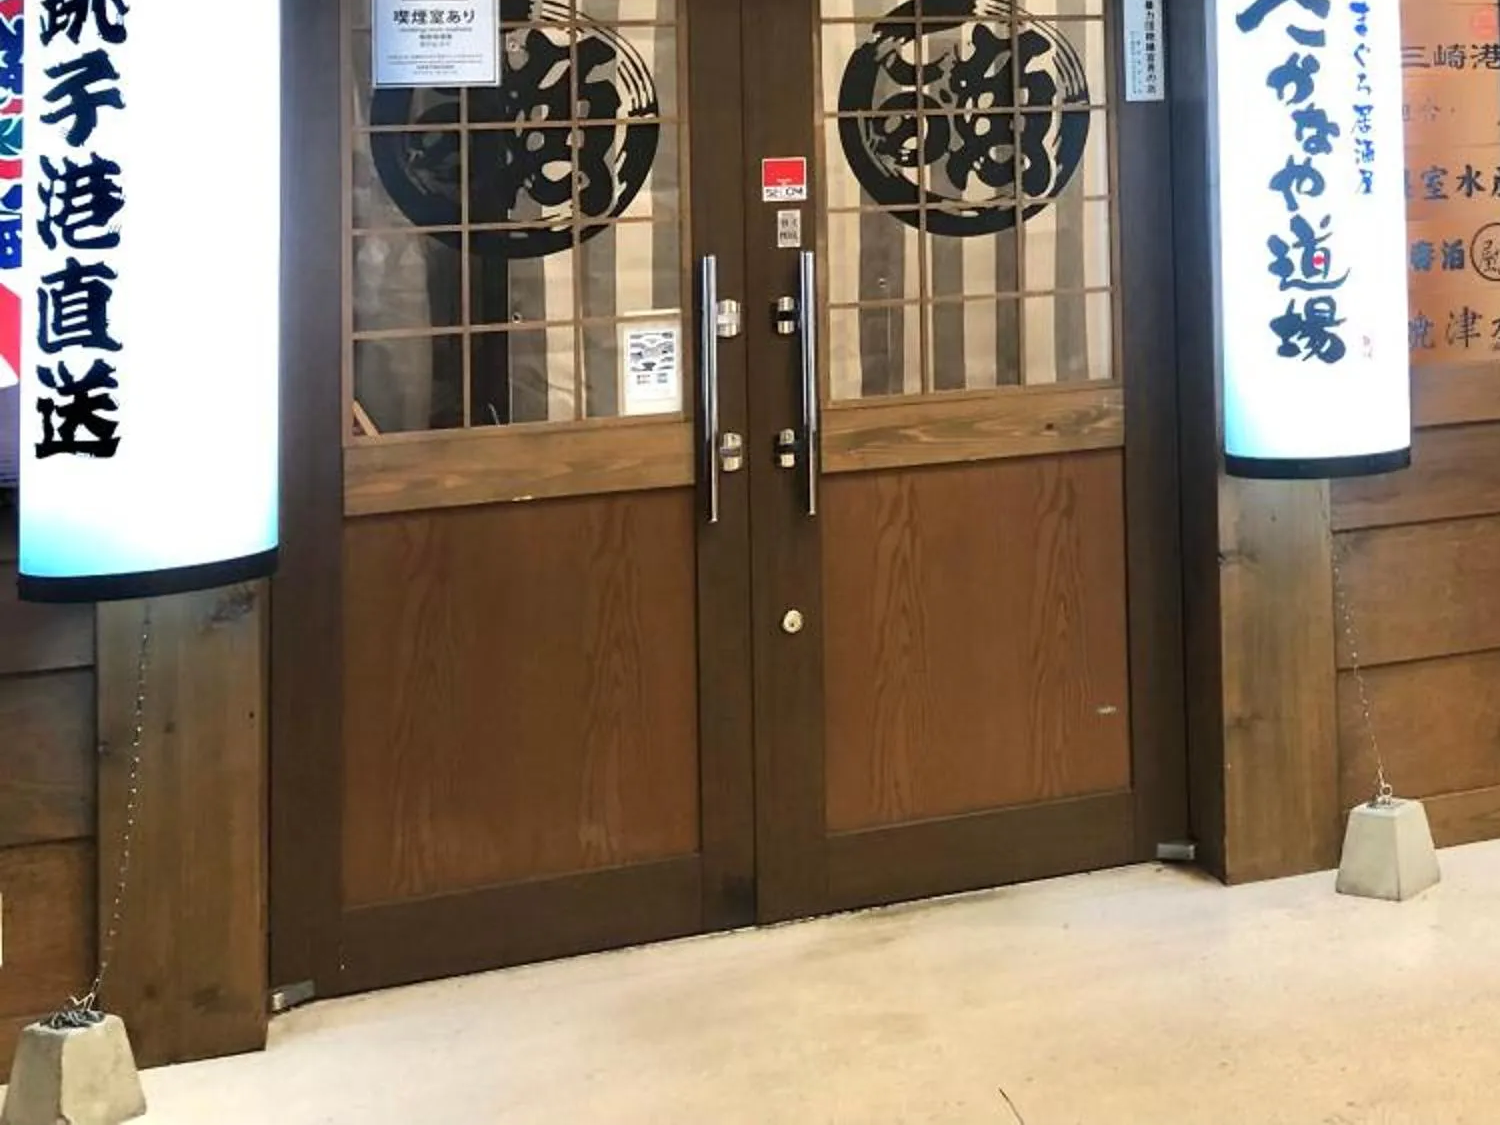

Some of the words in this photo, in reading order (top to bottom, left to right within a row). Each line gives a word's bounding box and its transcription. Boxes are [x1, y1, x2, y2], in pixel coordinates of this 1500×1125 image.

[393, 9, 475, 25] 喫煙室あり
